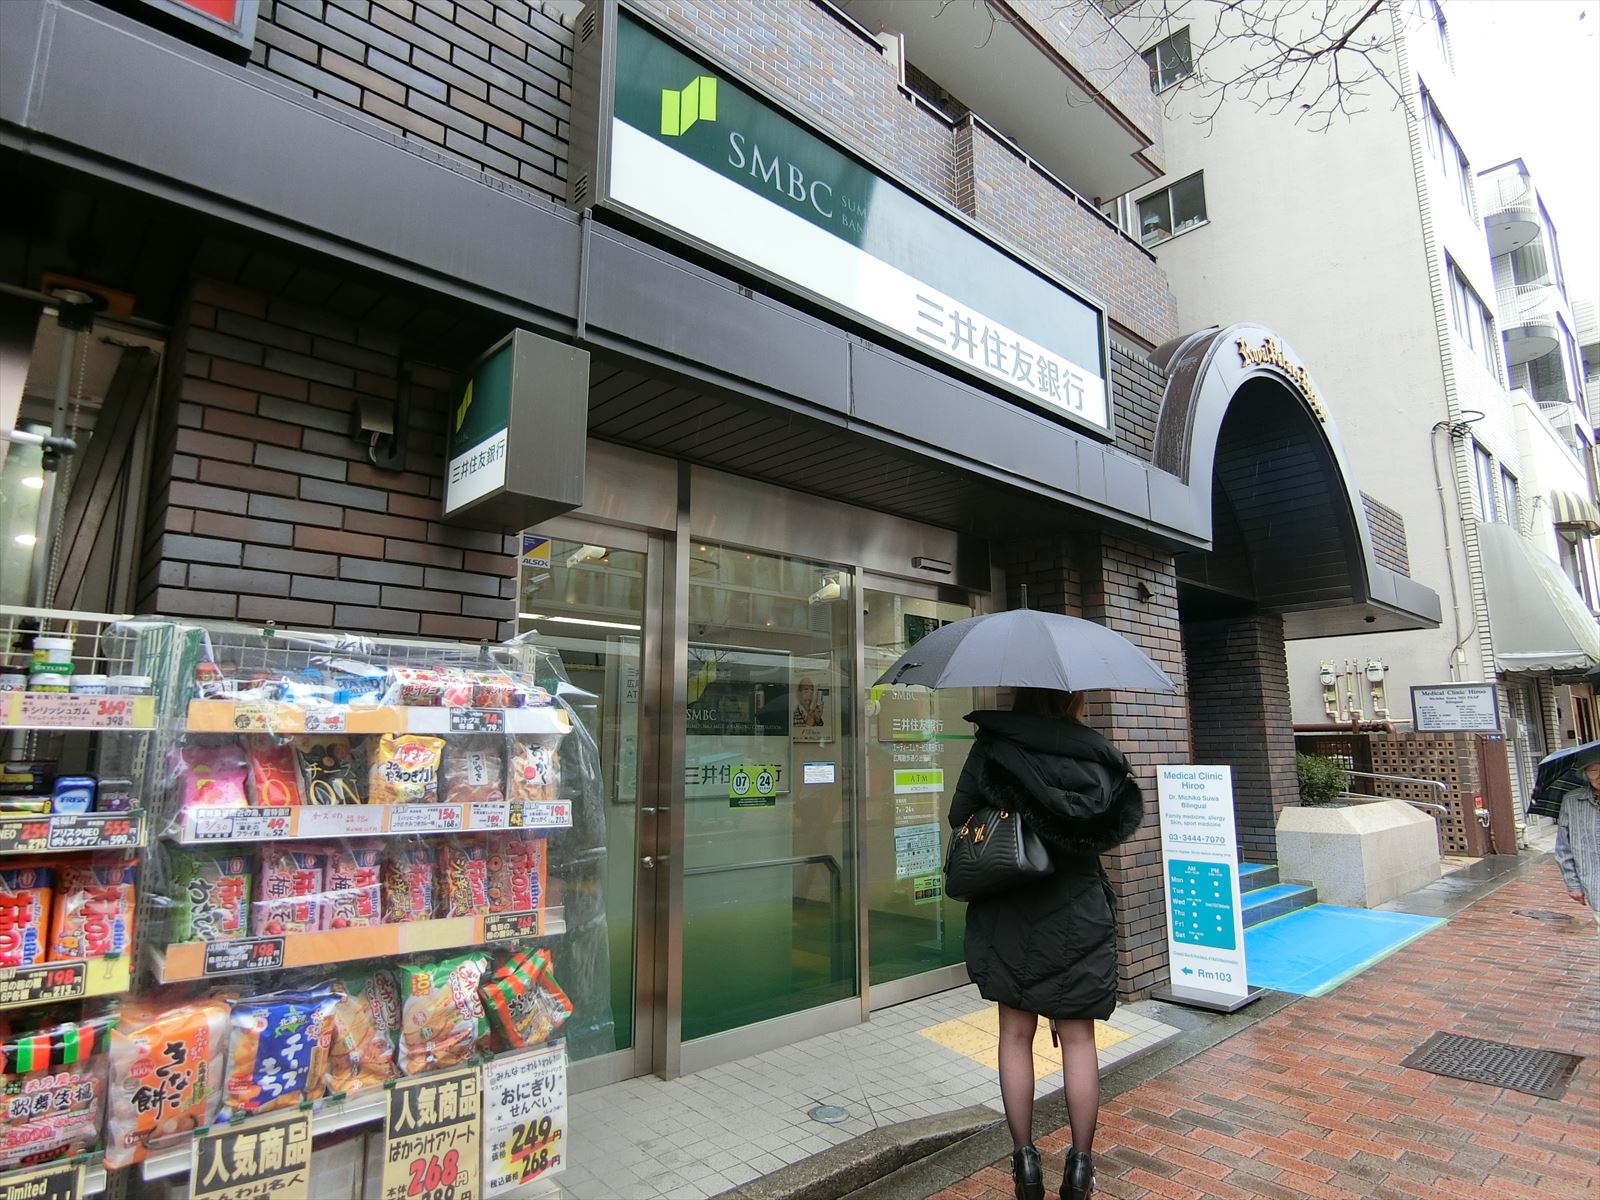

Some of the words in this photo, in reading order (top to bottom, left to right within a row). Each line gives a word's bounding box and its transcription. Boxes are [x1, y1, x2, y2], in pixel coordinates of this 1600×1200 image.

[728, 131, 833, 218] SMBC
[916, 293, 1084, 411] 三井住友銀行
[452, 438, 506, 484] 三井住友銀行
[522, 558, 548, 567] ALSOK
[22, 706, 90, 715] キシリッシュガム
[97, 700, 125, 716] 369
[106, 716, 124, 726] 398
[686, 709, 717, 721] SMBC
[735, 776, 747, 787] 07
[759, 775, 771, 787] 24
[911, 775, 928, 783] ATM
[1163, 771, 1196, 780] Medical
[1198, 772, 1223, 781] Clinic
[1181, 782, 1205, 790] Hiroo
[438, 808, 456, 820] 156
[266, 818, 285, 829] 49
[443, 820, 455, 828] 168
[53, 828, 99, 838] フリスクNEO
[272, 829, 284, 837] 52
[51, 836, 97, 847] ボトルタイプ
[1197, 968, 1232, 983] Rm103
[458, 965, 486, 1018] ばかうけ
[281, 1033, 309, 1089] チーズ
[501, 1074, 555, 1106] おにぎり
[131, 1080, 168, 1120] 餅
[394, 1075, 477, 1132] 人気商品
[509, 1096, 552, 1117] せんべい
[389, 1124, 475, 1163] ばかうけアソート
[491, 1141, 506, 1152] 本体
[203, 1120, 309, 1187] 人気商品
[491, 1150, 506, 1162] 価格
[490, 1171, 519, 1189] 税込価格
[387, 1183, 407, 1197] 本体
